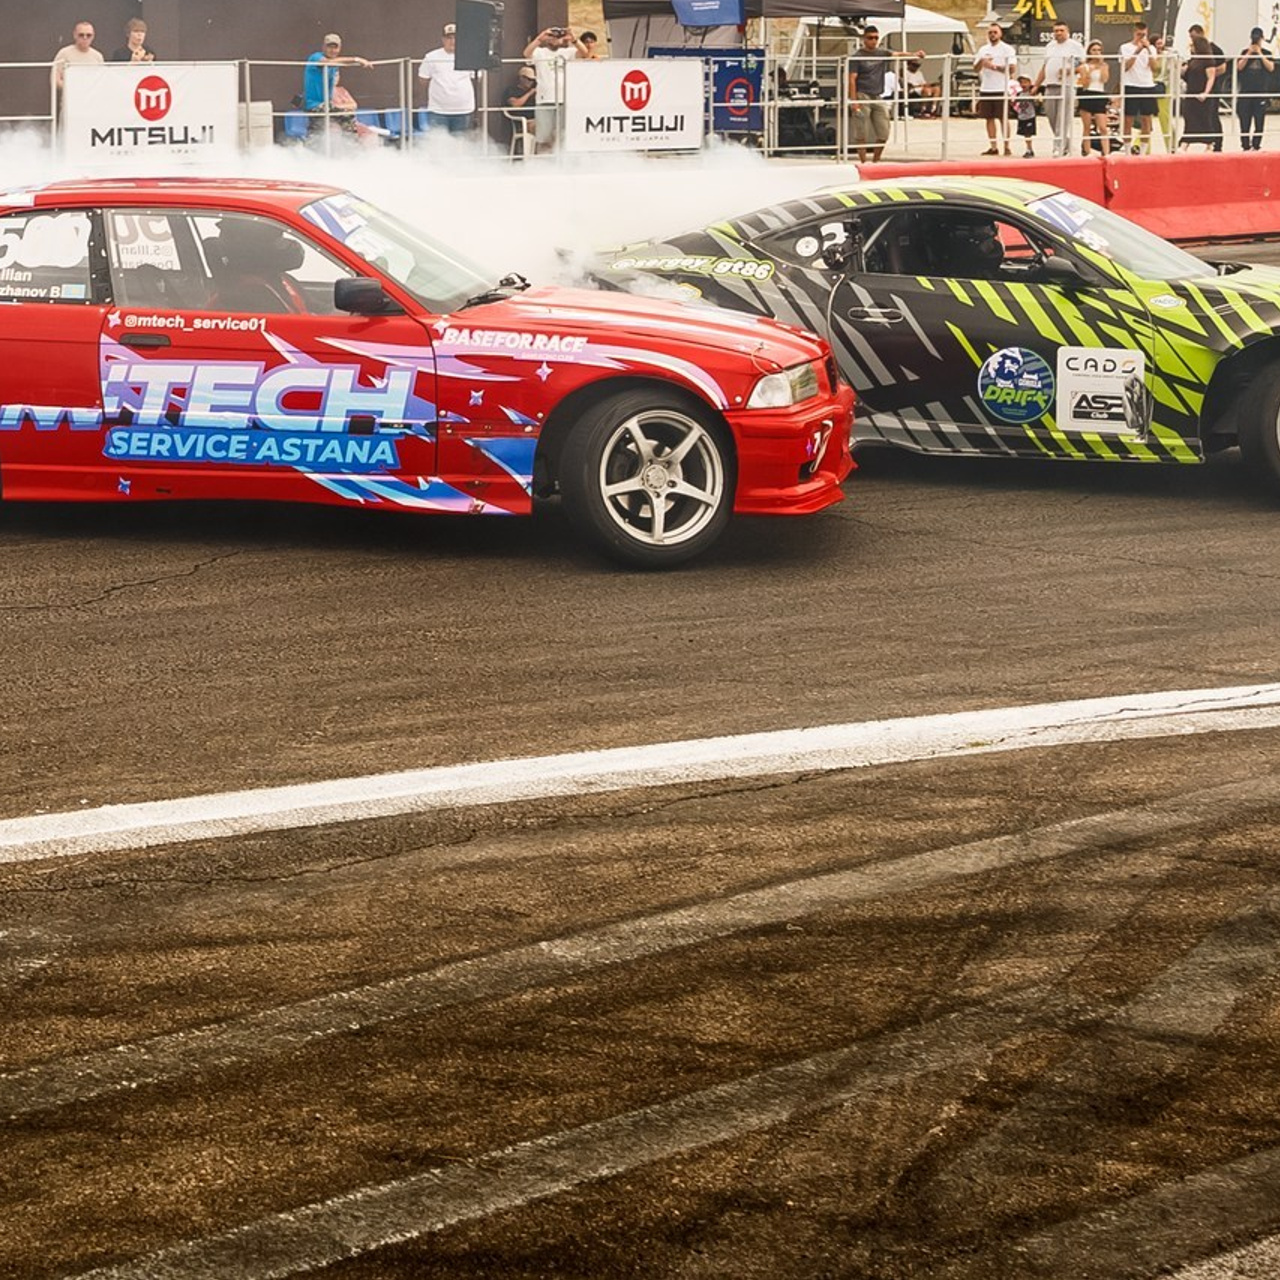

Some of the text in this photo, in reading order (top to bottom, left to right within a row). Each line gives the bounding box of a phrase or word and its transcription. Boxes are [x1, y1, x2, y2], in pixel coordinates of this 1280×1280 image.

[585, 115, 684, 133] MITSUJI
[91, 125, 214, 147] MITSUJI
[109, 429, 395, 465] SERVICE ASTANA
